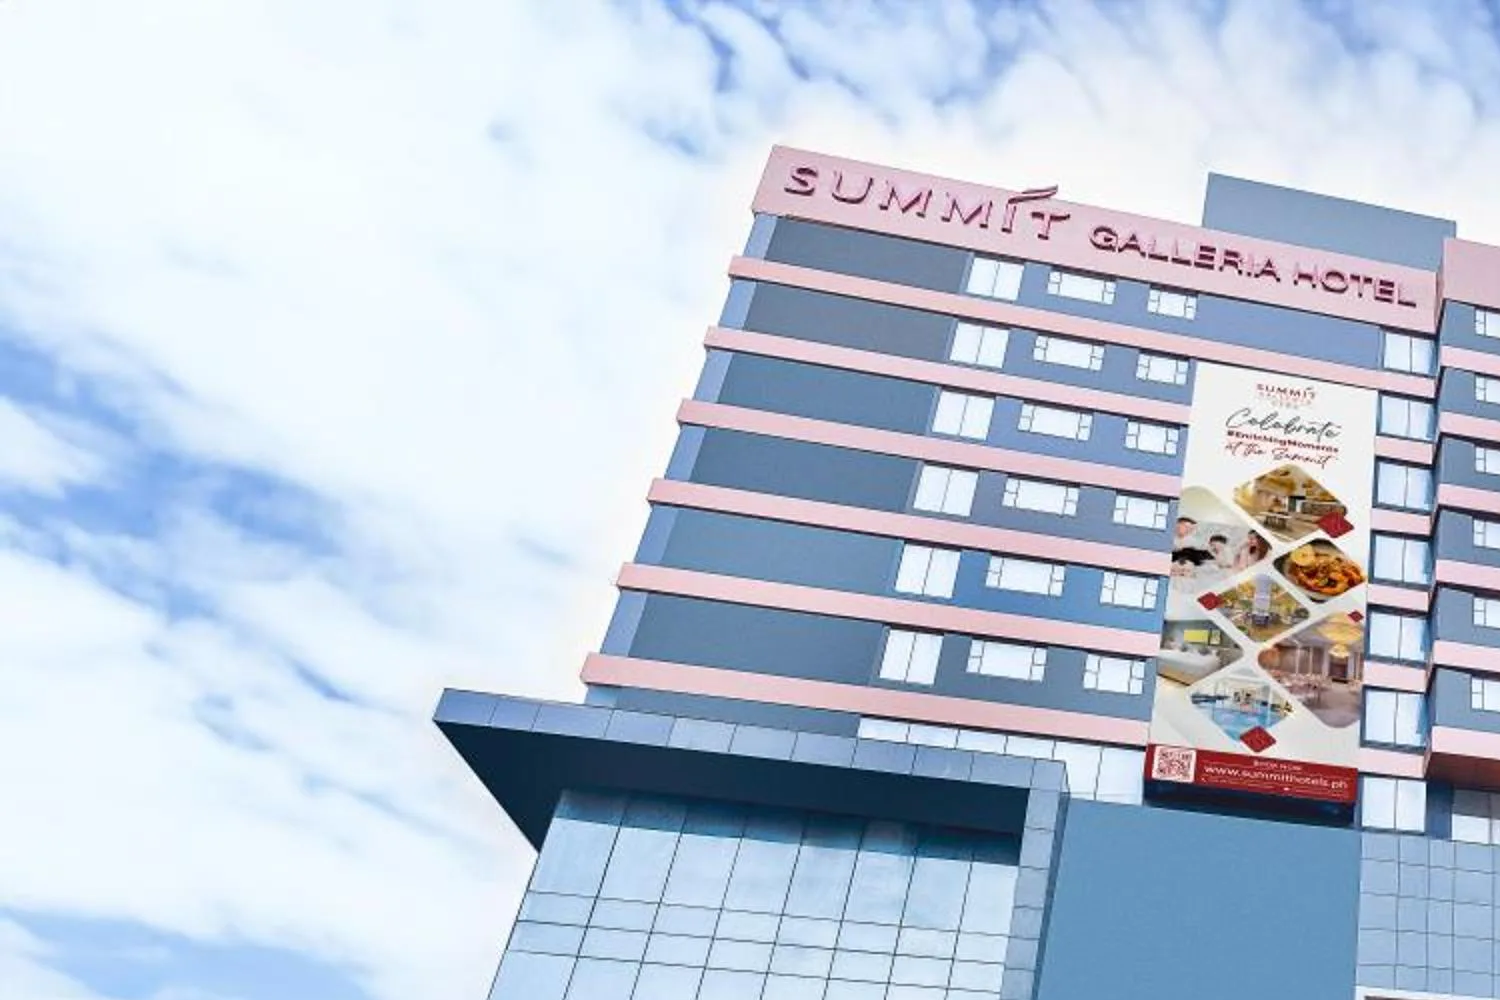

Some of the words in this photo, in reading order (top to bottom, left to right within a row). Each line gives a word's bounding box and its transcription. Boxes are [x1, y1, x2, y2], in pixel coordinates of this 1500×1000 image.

[784, 166, 1071, 240] SUMMIT
[1088, 225, 1282, 283] GALLERIA
[1292, 262, 1417, 308] HOTEL
[1225, 407, 1342, 442] Celebrate
[1203, 764, 1349, 790] www.summithotels.ph
